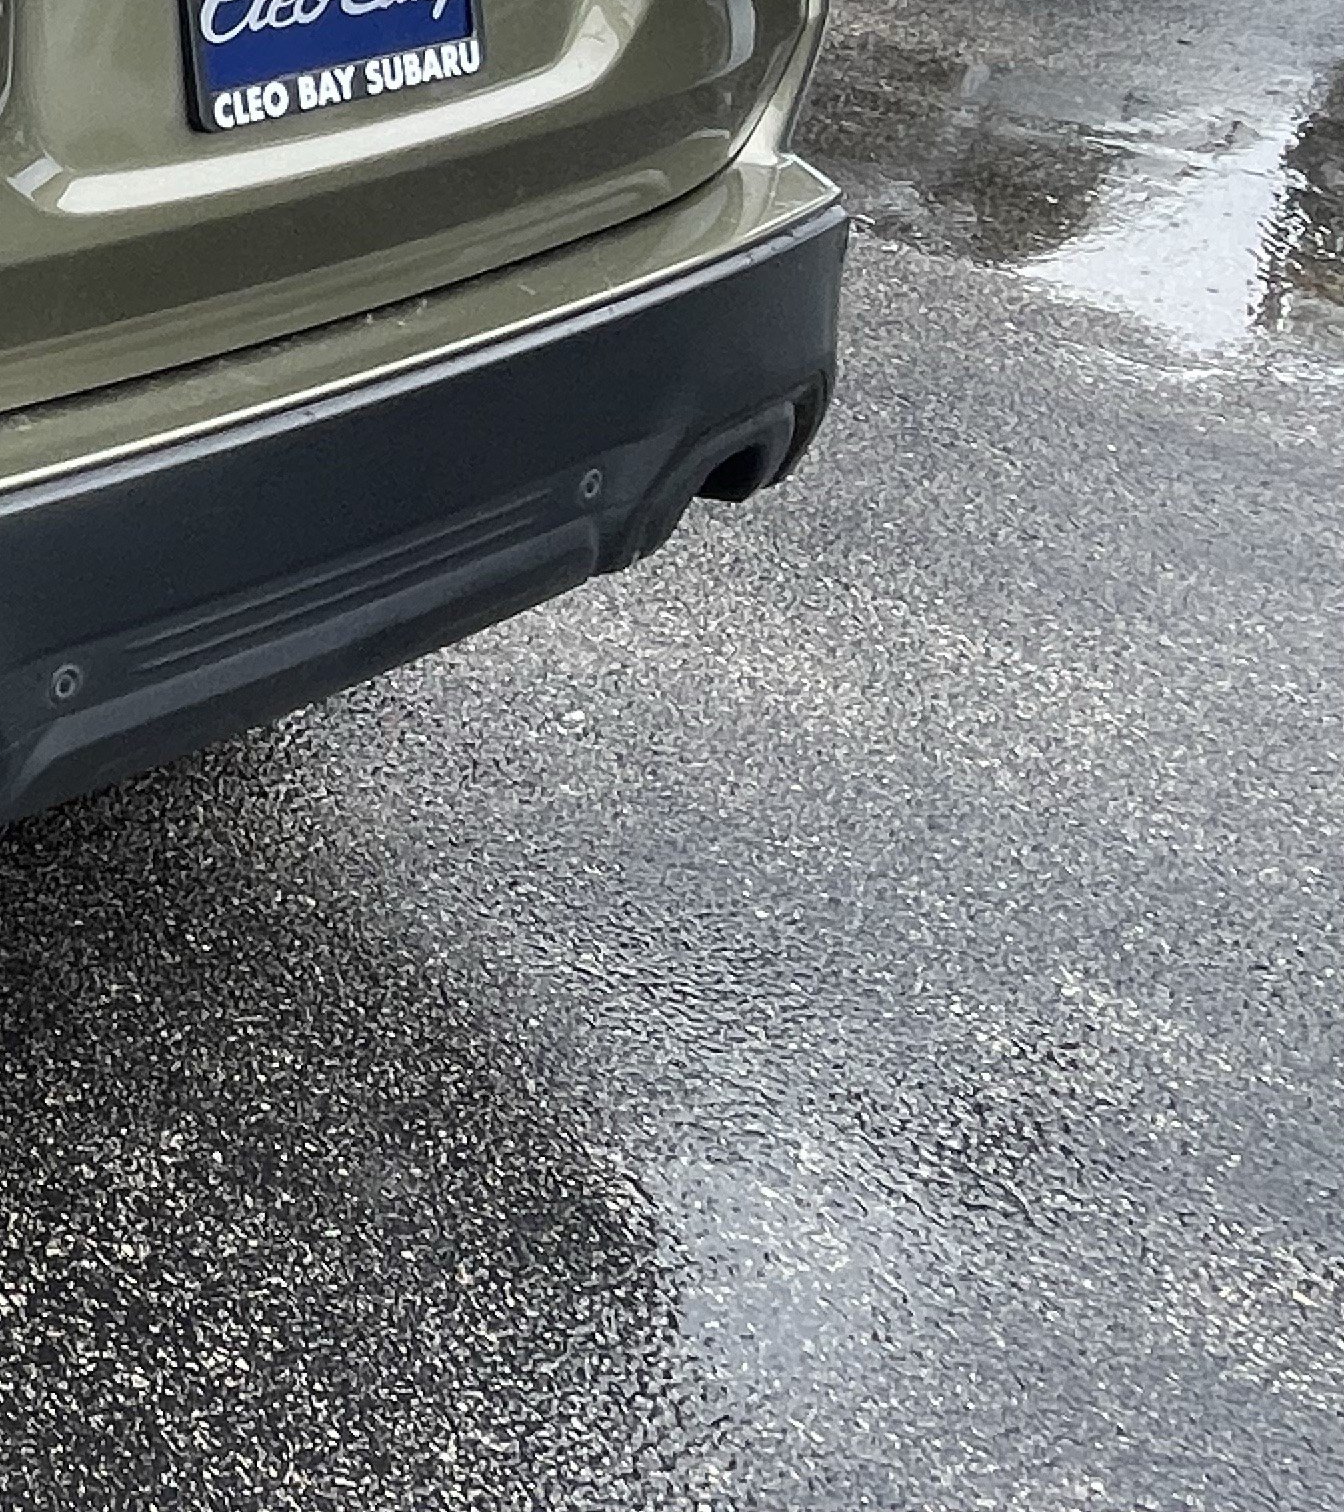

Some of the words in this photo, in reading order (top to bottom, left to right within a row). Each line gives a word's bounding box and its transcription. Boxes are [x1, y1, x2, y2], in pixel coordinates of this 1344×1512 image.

[214, 82, 290, 129] CLEO
[297, 66, 357, 111] BAY
[365, 39, 481, 96] SUBARU
